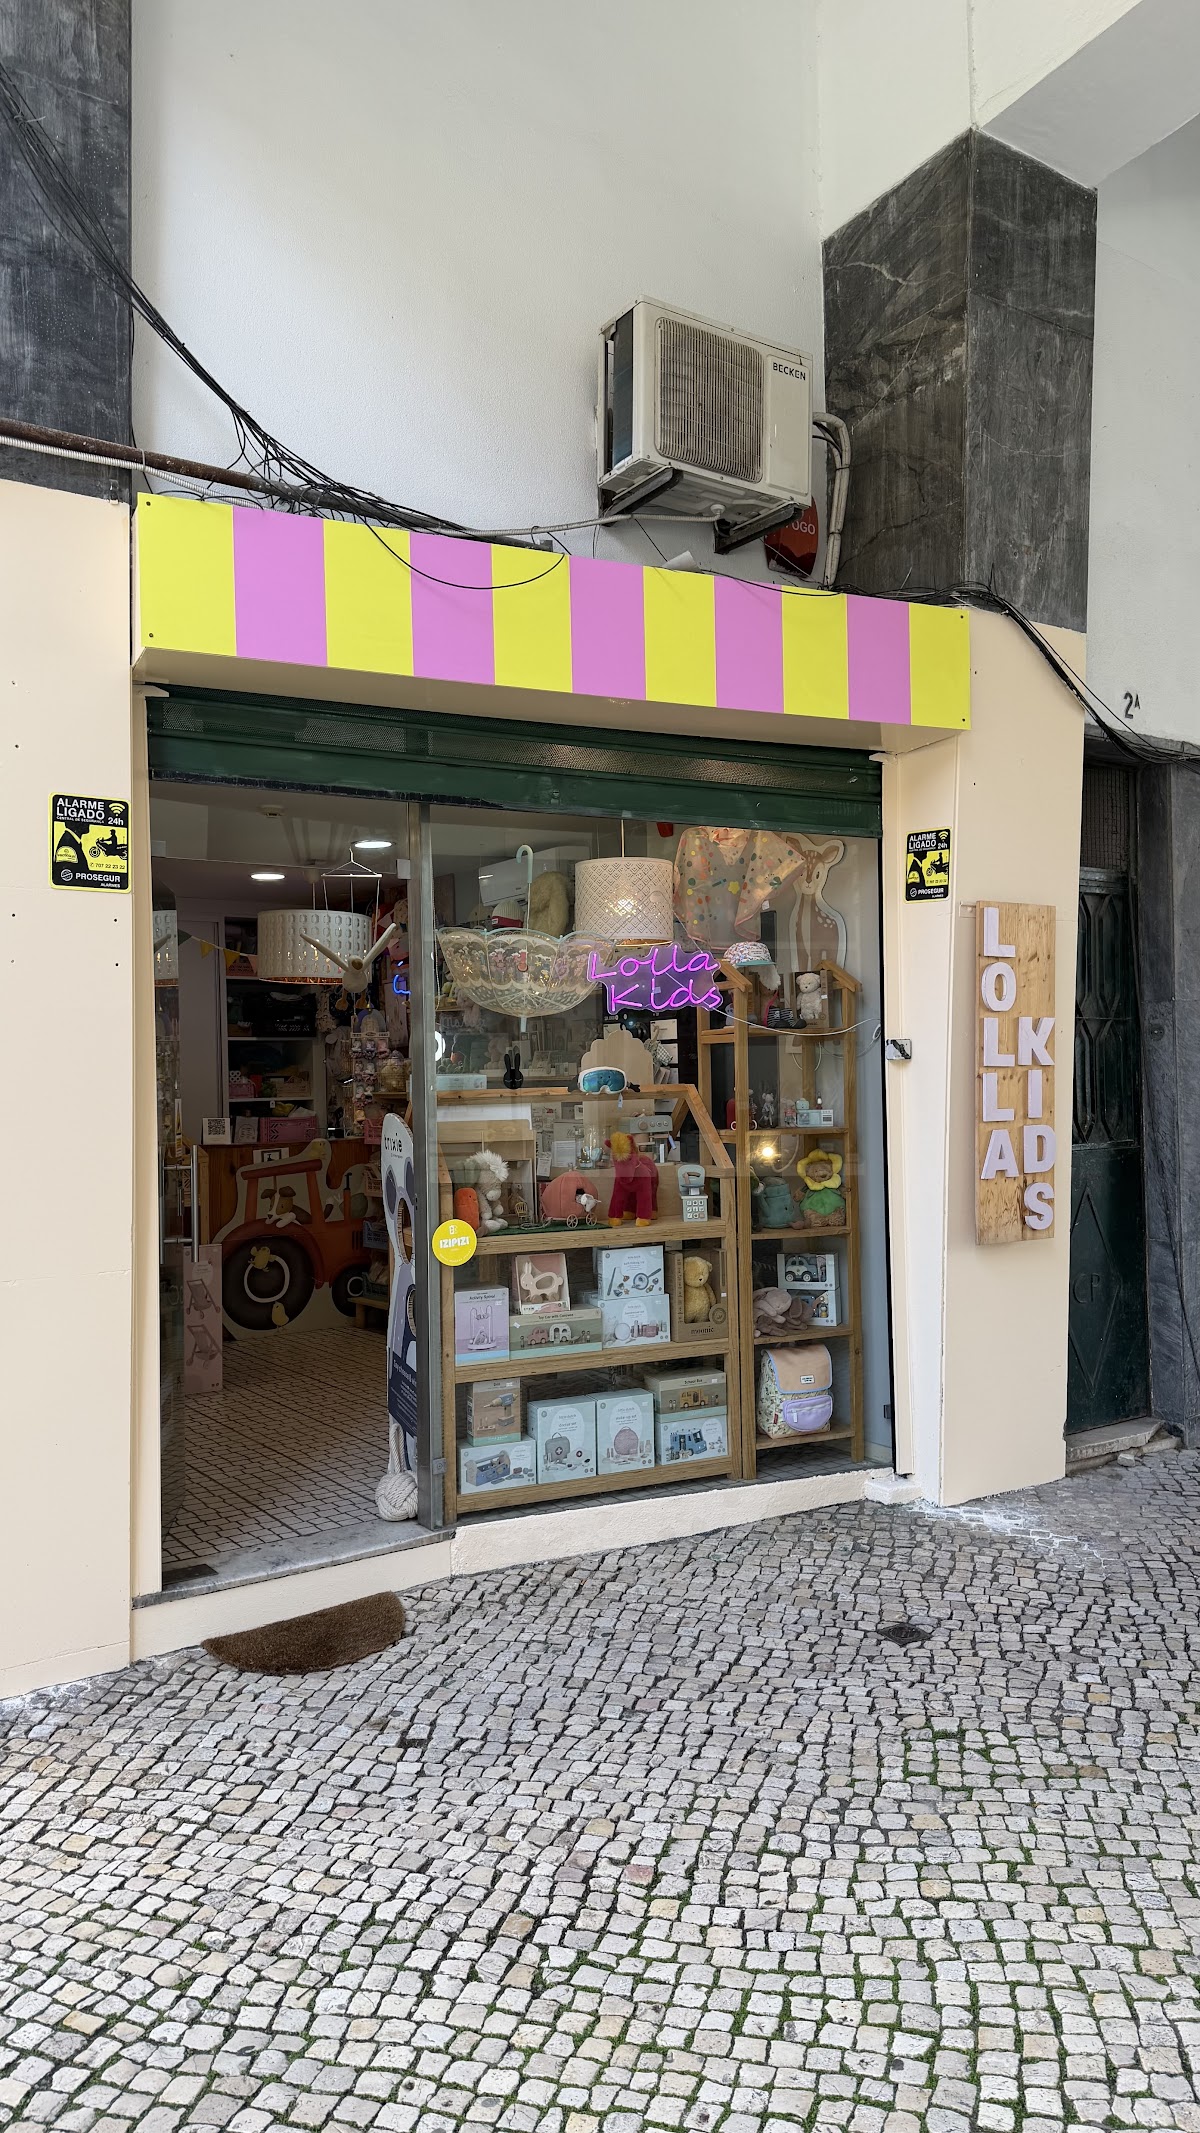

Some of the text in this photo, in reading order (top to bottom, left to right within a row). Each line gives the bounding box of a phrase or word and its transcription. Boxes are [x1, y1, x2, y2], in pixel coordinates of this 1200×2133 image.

[773, 361, 806, 381] BECKEN
[785, 520, 816, 535] OGO
[57, 797, 105, 811] ALARME
[56, 806, 124, 826] LIGADO 24h
[908, 840, 937, 850] LIGADO
[937, 842, 948, 850] 24h
[909, 832, 937, 842] ALARME
[75, 873, 121, 882] PROSEGUR
[917, 887, 945, 895] PROSEGUR
[590, 944, 719, 980] Lolla
[610, 978, 722, 1012] Kids
[980, 906, 1020, 1179] LOLLA
[1017, 1016, 1057, 1230] KIDS
[384, 1132, 403, 1153] trixie
[439, 1236, 470, 1249] IZIPIZI
